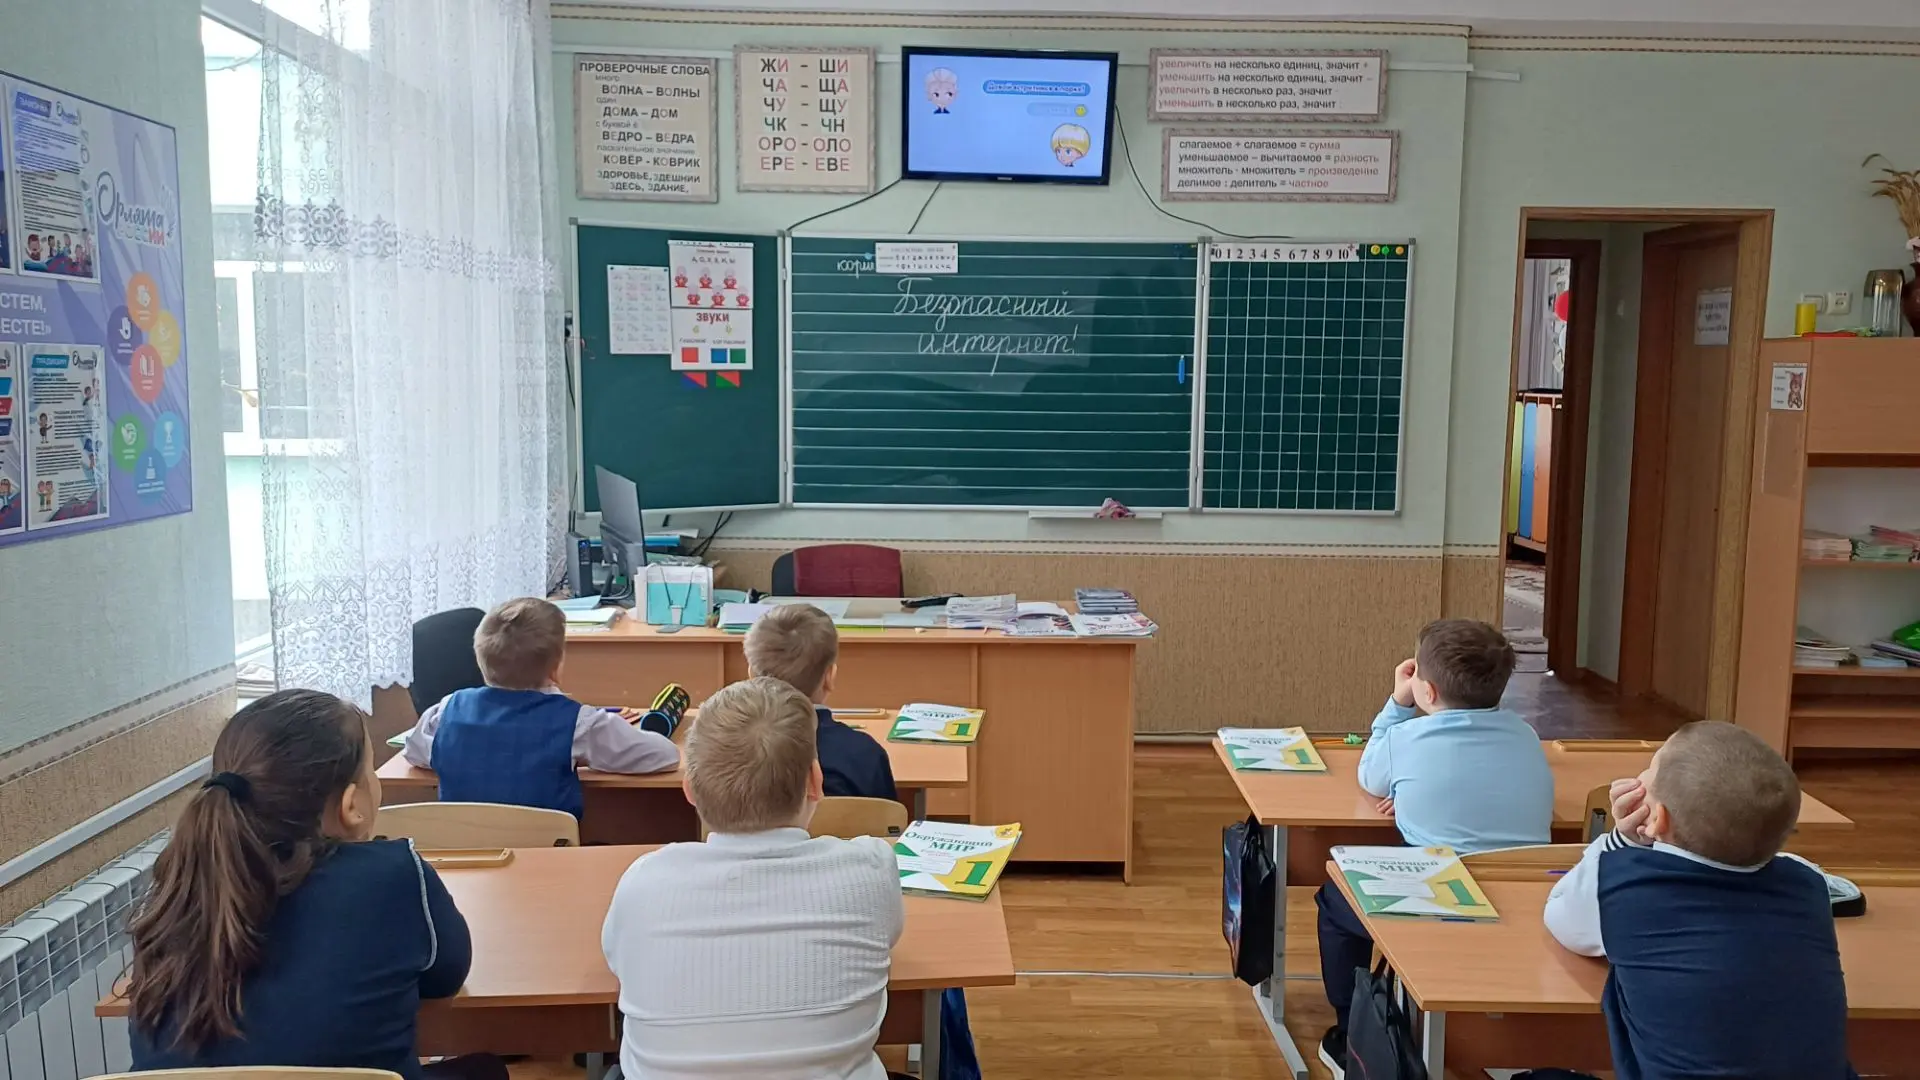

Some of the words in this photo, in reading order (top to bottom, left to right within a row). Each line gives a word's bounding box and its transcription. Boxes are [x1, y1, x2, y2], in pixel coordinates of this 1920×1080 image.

[580, 62, 668, 74] ПРОВЕРОЧНЫЕ
[671, 65, 710, 76] СЛОВА
[760, 58, 789, 73] ЖИ
[819, 58, 849, 73] ШИ
[1160, 61, 1212, 70] увеличить
[1214, 61, 1226, 69] на
[1230, 61, 1280, 69] несколько
[1283, 62, 1323, 71] единиц,
[1326, 62, 1360, 70] значит
[1160, 73, 1215, 82] уменьшить
[1218, 74, 1230, 82] на
[1233, 74, 1285, 82] несколько
[1287, 74, 1327, 84] единиц,
[1330, 75, 1363, 83] значит
[602, 84, 643, 96] ВОЛНА
[656, 87, 700, 98] ВОЛНЫ
[762, 78, 788, 92] ЧА
[819, 78, 849, 95] ЩА
[1160, 86, 1210, 95] увеличить
[1222, 87, 1273, 95] несколько
[1276, 88, 1296, 97] раз,
[764, 98, 786, 112] ЧУ
[819, 98, 847, 115] ЩУ
[1159, 100, 1214, 109] уменьшить
[1226, 100, 1277, 109] несколько
[1280, 101, 1299, 110] раз,
[1302, 101, 1336, 109] значит
[603, 106, 638, 117] ДОМА
[651, 108, 678, 119] ДОМ
[764, 117, 787, 131] ЧК
[821, 118, 845, 132] ЧН
[602, 130, 643, 142] ВЕДРО
[758, 136, 797, 151] ОРО
[814, 138, 851, 153] ОЛО
[1180, 140, 1233, 149] слагаемое
[1244, 141, 1297, 150] слагаемое
[1309, 142, 1341, 152] сумма
[653, 156, 701, 168] КОВРИК
[760, 156, 796, 171] ЕРЕ
[816, 158, 850, 172] ЕВЕ
[1179, 154, 1249, 163] уменьшаемое
[1260, 154, 1322, 163] вычитаемое
[1334, 154, 1379, 165] разность
[1178, 166, 1233, 175] множитель
[1242, 167, 1297, 176] множитель
[1308, 168, 1379, 177] произведение
[1178, 180, 1221, 188] делимое
[1230, 180, 1278, 189] делитель
[1288, 180, 1329, 189] частное
[1216, 248, 1222, 260] 0
[1227, 248, 1232, 260] 1
[1237, 248, 1244, 260] 2
[1249, 248, 1256, 260] 3
[1260, 248, 1267, 260] 4
[1273, 248, 1281, 260] 5
[1288, 248, 1296, 260] 6
[1300, 248, 1308, 260] 7
[1313, 248, 1320, 260] 8
[1326, 248, 1333, 260] 9
[1338, 248, 1349, 260] 10
[696, 312, 730, 325] ЗВУКИ
[917, 324, 1079, 377] интернет!
[1288, 748, 1319, 765] 1
[954, 860, 993, 887] 1
[1436, 879, 1486, 906] 1
